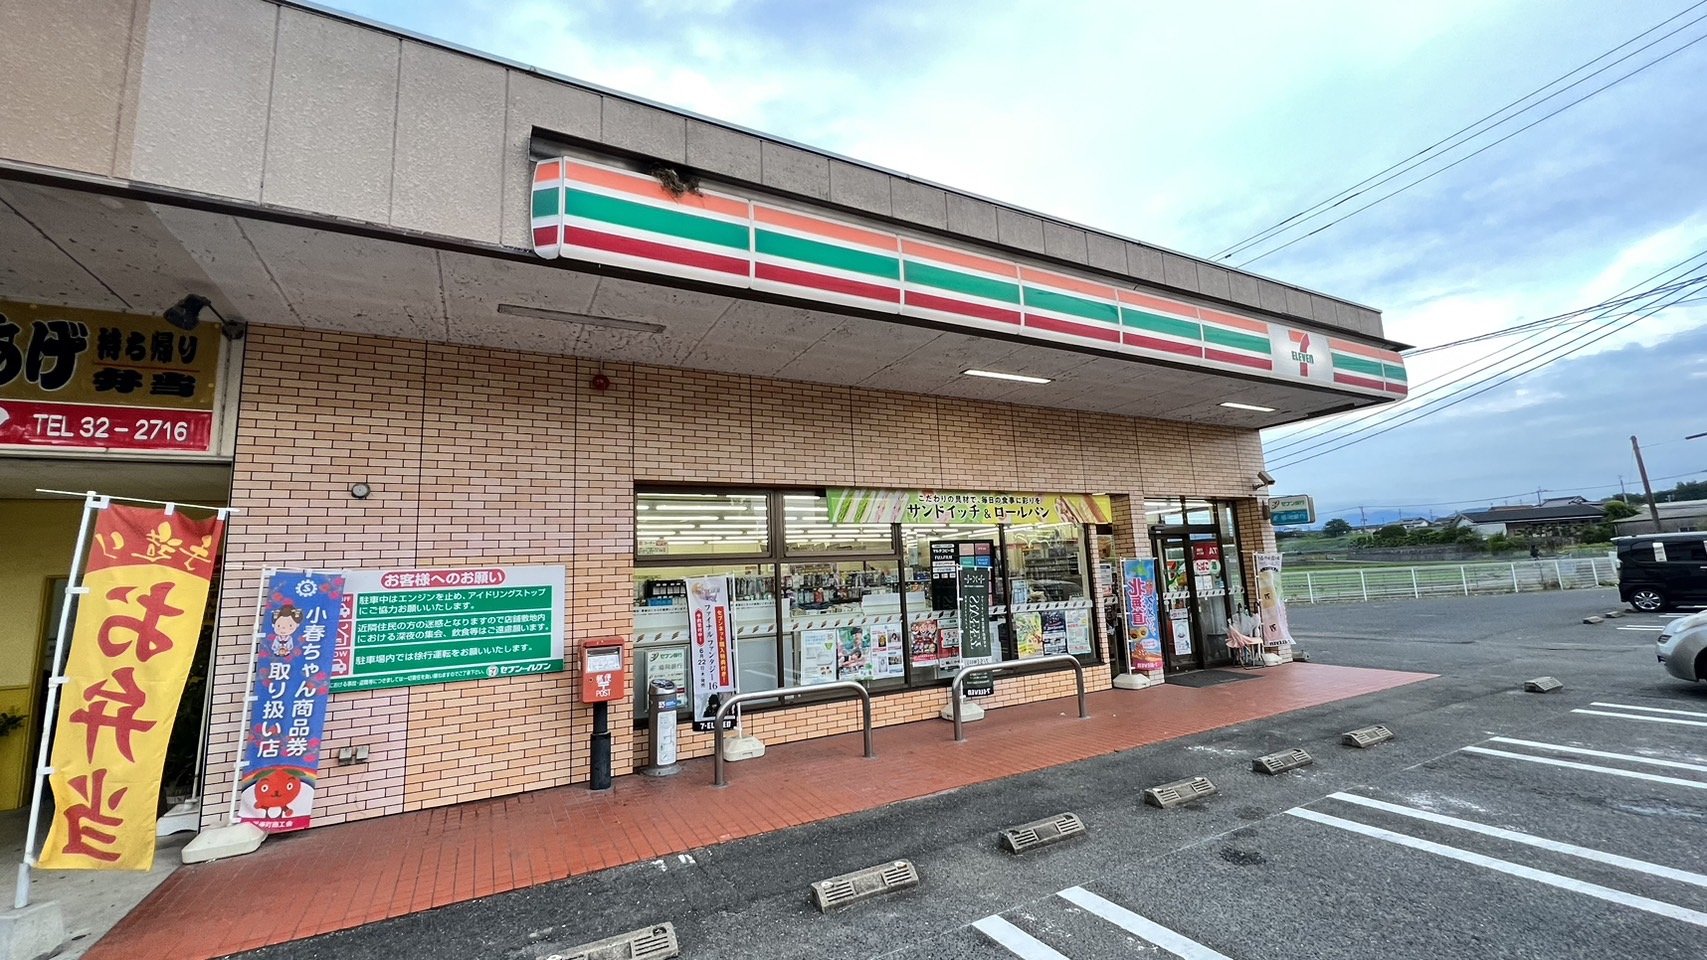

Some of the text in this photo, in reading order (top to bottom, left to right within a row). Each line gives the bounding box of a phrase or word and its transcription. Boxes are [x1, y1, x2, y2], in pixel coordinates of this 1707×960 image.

[97, 327, 198, 364] 持ち帰り
[92, 367, 196, 397] 弁当
[33, 413, 74, 437] TEL
[907, 503, 981, 521] サンドイッチ
[984, 509, 992, 519] &
[383, 569, 503, 588] お客様へのお願い
[358, 588, 546, 605] 駐車中はエンジンを止め、アイドリングストップ
[358, 602, 475, 615] にご協力お願いいたします。
[355, 643, 533, 666] 駐車場内では徐行運転をお願いいたします。
[286, 606, 327, 757] 小春ちゃん商品券
[708, 682, 718, 690] 16
[595, 689, 611, 697] POST
[257, 662, 291, 758] 取り扱い店
